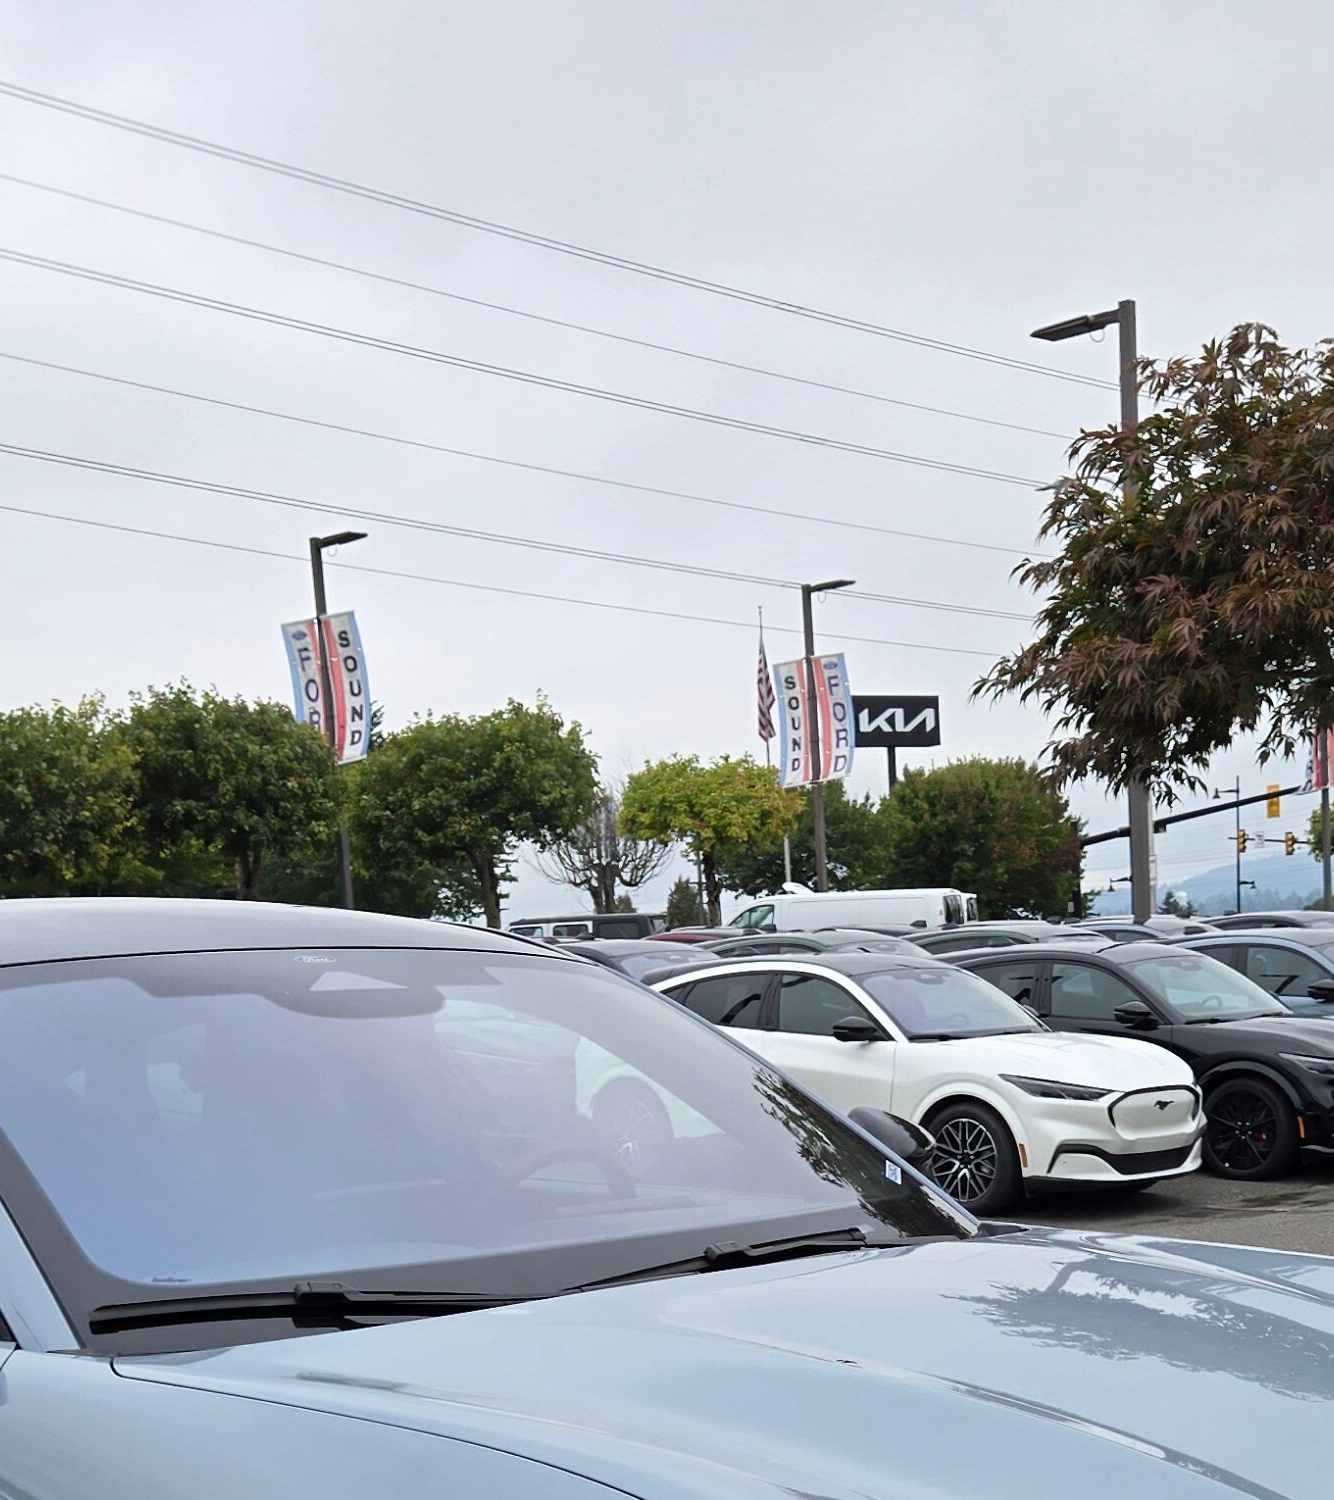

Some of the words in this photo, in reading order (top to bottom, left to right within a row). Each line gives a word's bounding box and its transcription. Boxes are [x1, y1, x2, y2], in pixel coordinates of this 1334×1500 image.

[296, 647, 321, 731] FOR
[338, 630, 364, 746] SOUND
[784, 675, 801, 772] SOUND
[827, 675, 849, 773] FORD
[857, 707, 936, 733] KIA
